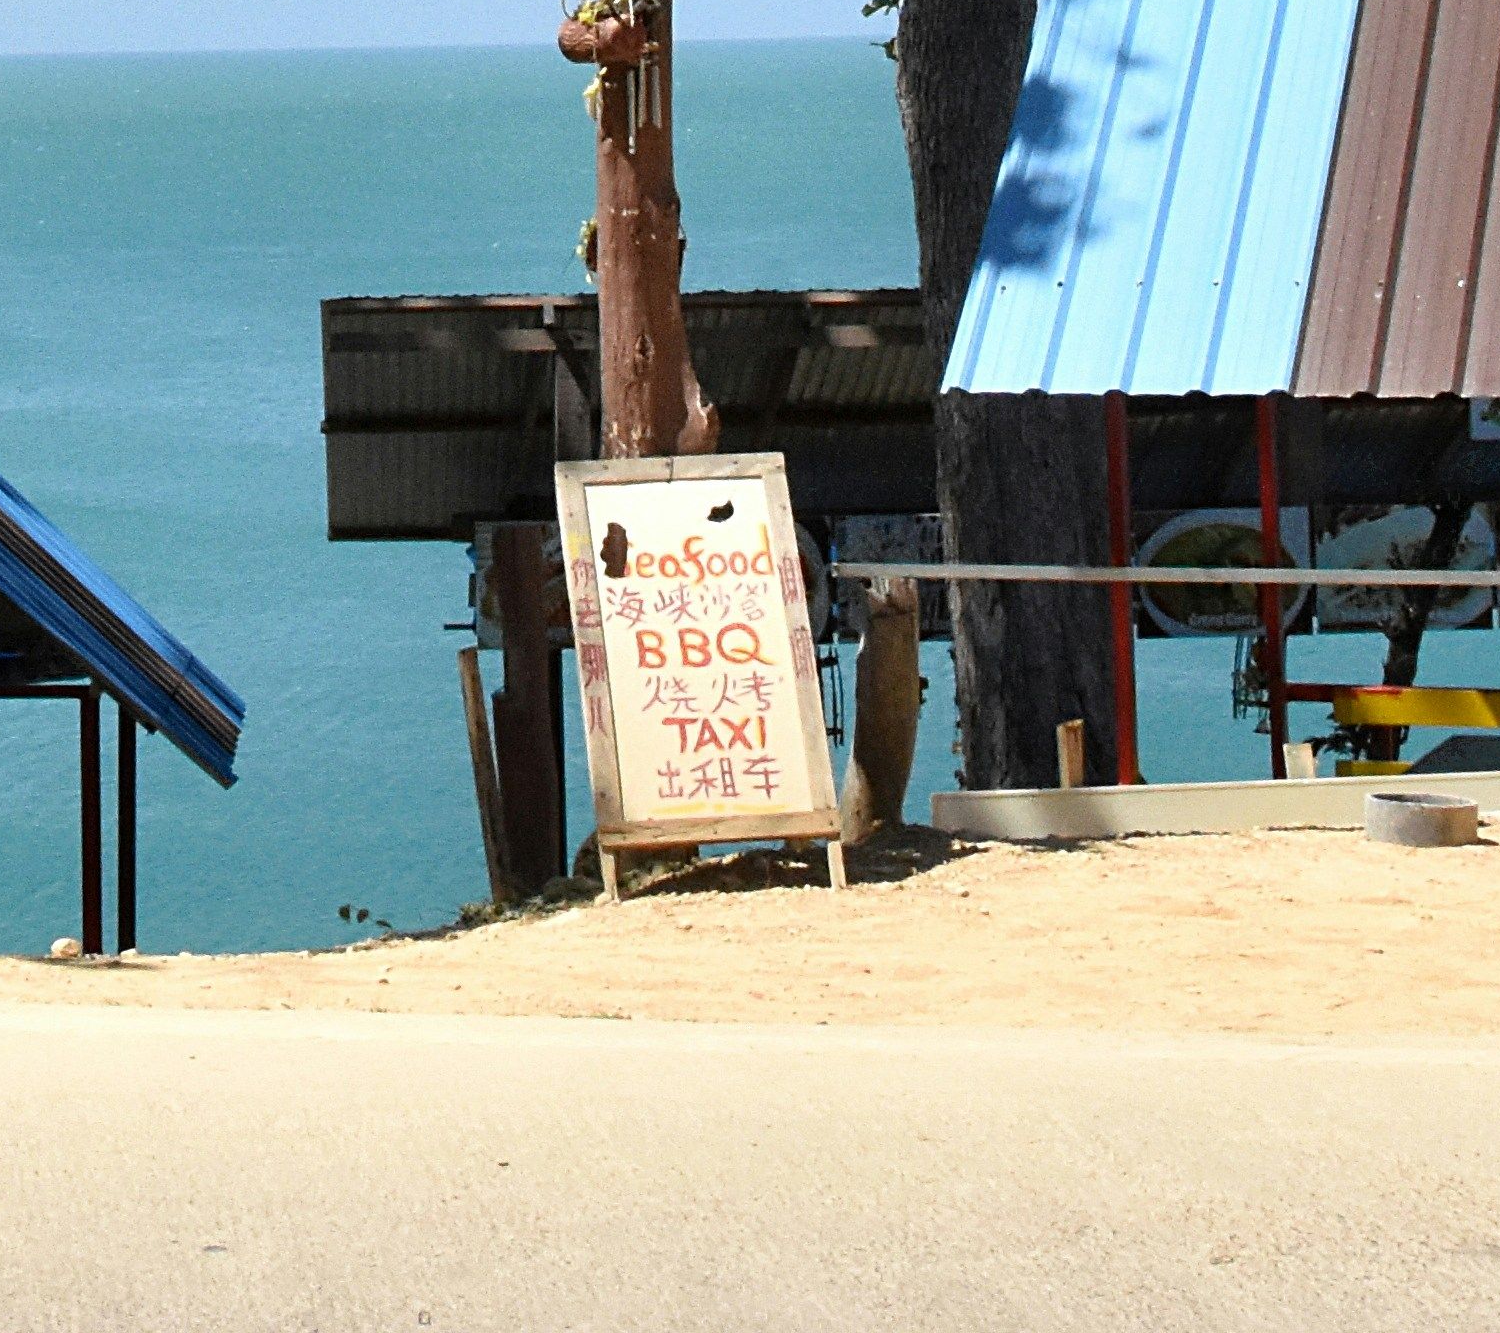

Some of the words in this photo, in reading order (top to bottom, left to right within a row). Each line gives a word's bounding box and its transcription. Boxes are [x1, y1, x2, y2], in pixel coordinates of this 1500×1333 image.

[622, 523, 775, 587] eafood
[641, 671, 775, 714] 烧烤
[661, 715, 767, 753] TAXI
[657, 754, 782, 800] 出租车
